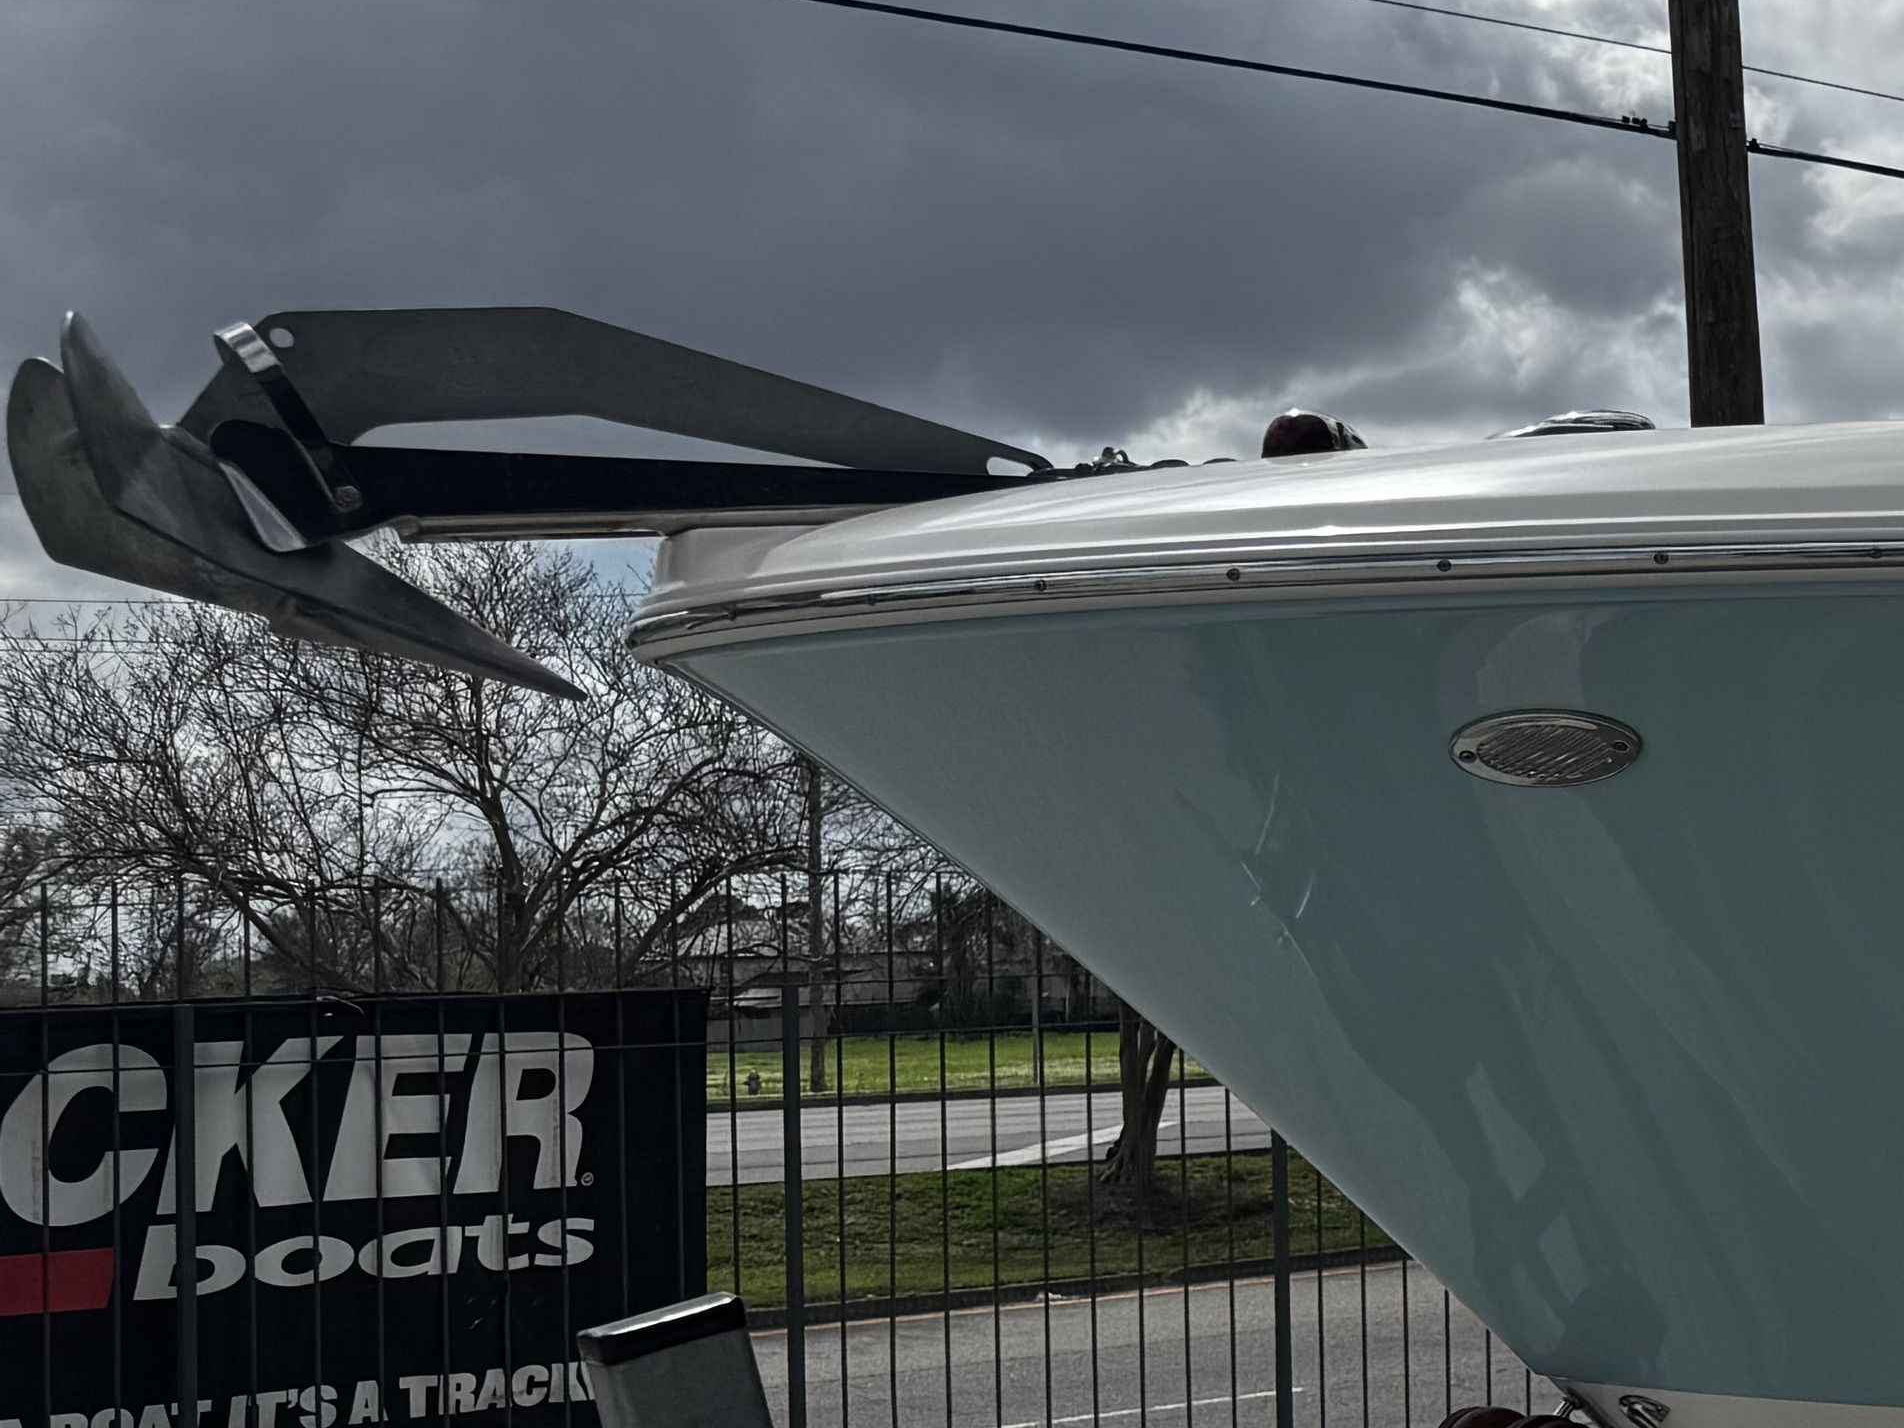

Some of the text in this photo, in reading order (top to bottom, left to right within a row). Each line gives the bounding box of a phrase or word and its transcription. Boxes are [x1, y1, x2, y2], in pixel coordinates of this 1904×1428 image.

[0, 1031, 594, 1227] CKER
[133, 1213, 594, 1301] boats
[348, 1379, 388, 1425] A
